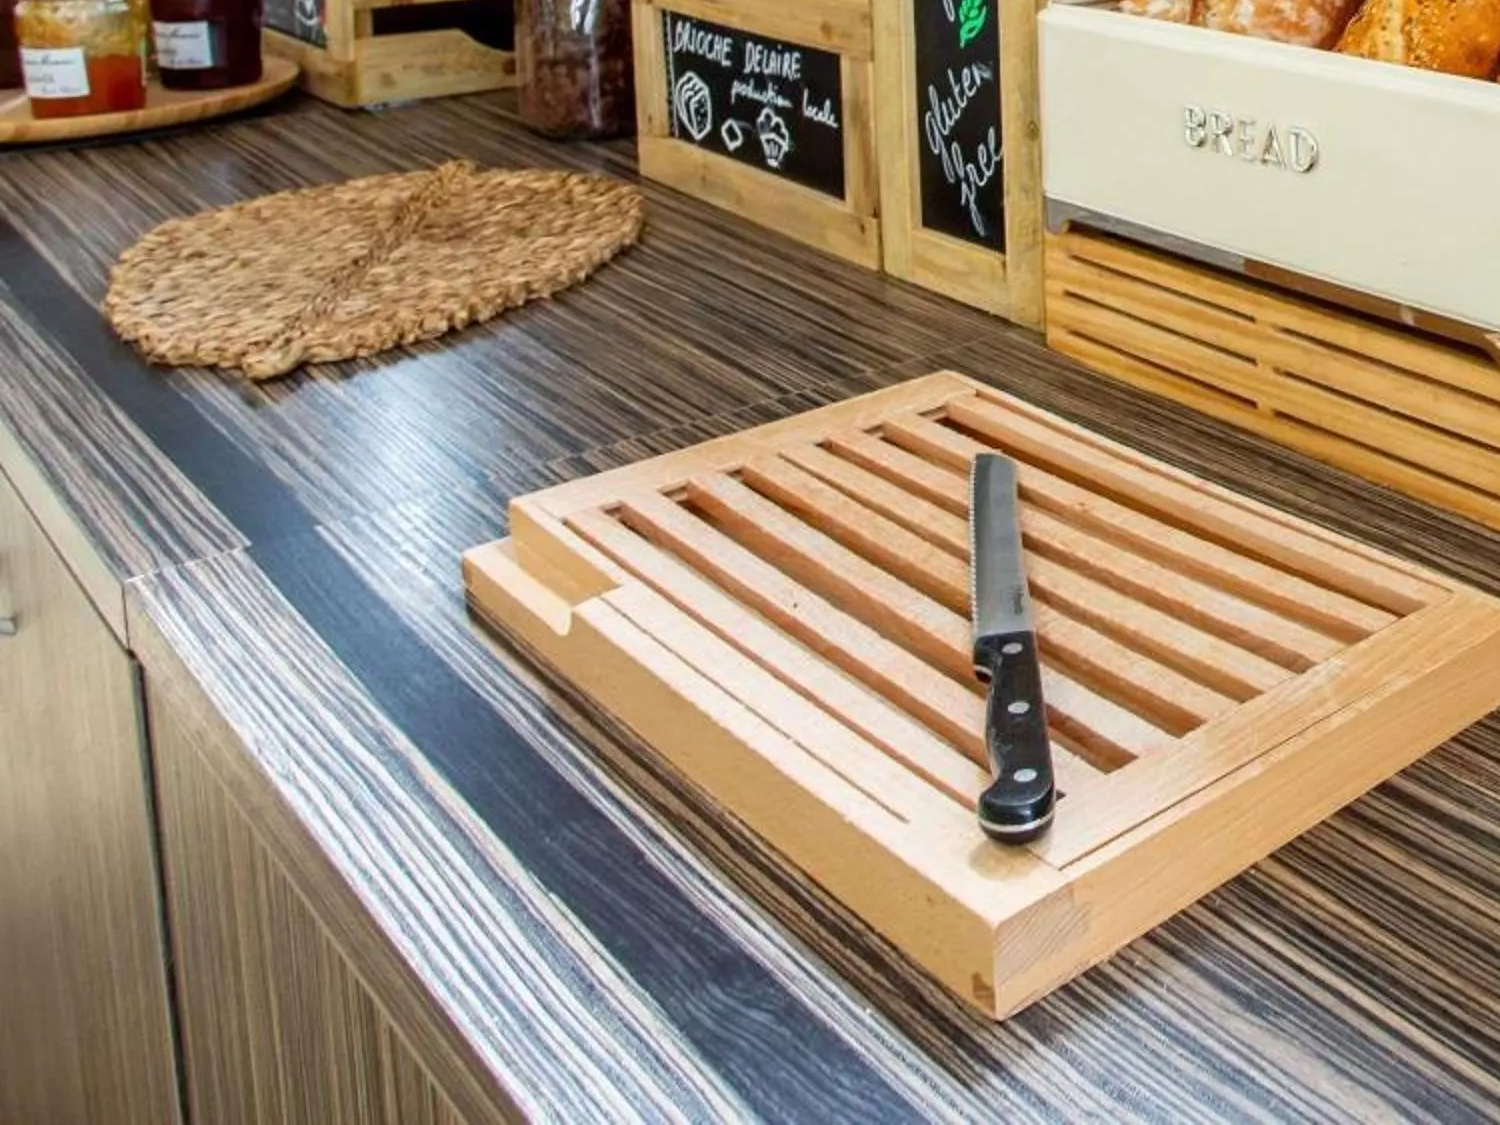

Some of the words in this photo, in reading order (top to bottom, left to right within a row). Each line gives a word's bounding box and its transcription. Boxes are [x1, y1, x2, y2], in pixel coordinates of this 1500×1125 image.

[925, 61, 994, 184] gluten
[1183, 103, 1320, 174] BREAD
[951, 126, 1004, 237] free
